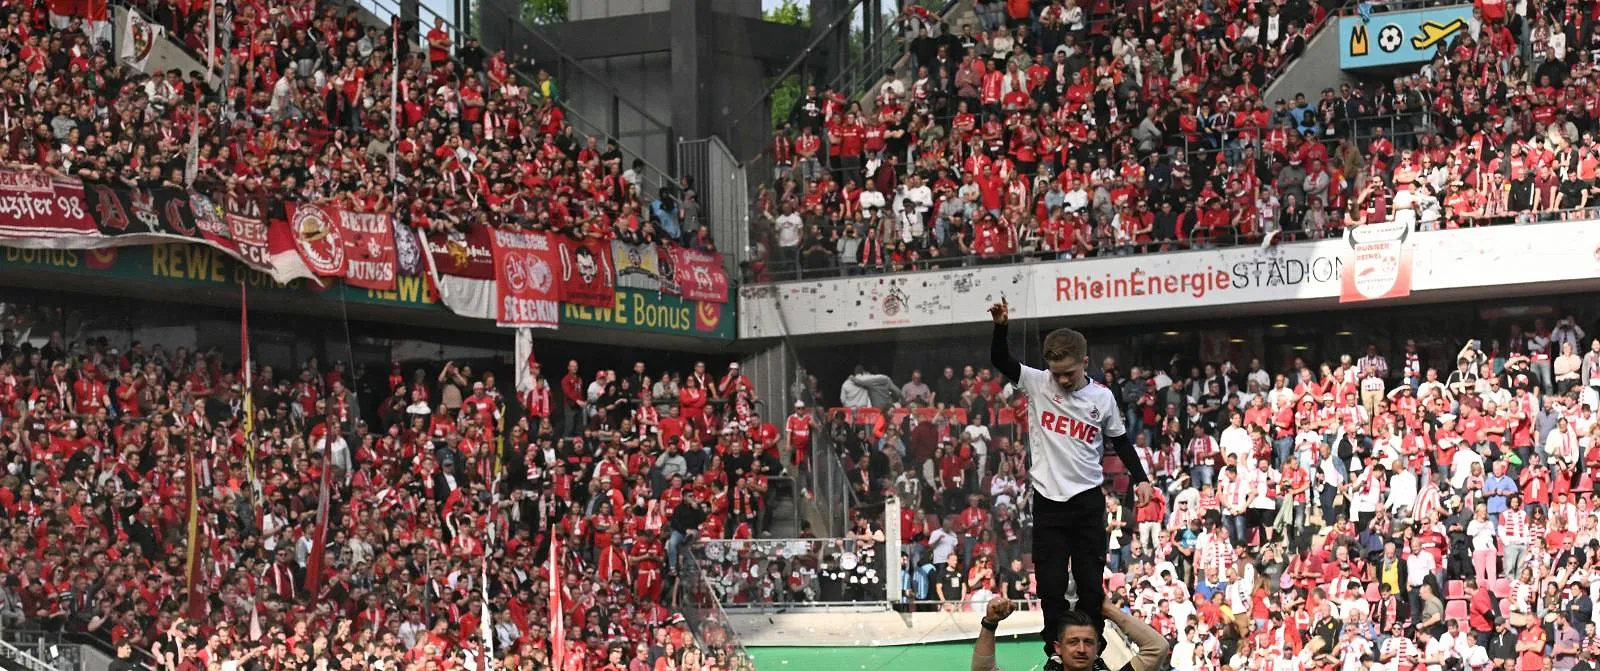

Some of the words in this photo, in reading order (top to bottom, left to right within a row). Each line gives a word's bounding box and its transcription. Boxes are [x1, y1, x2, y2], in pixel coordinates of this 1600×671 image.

[152, 245, 225, 282] REWE
[633, 293, 690, 330] Bonus
[1041, 410, 1099, 445] REWE
